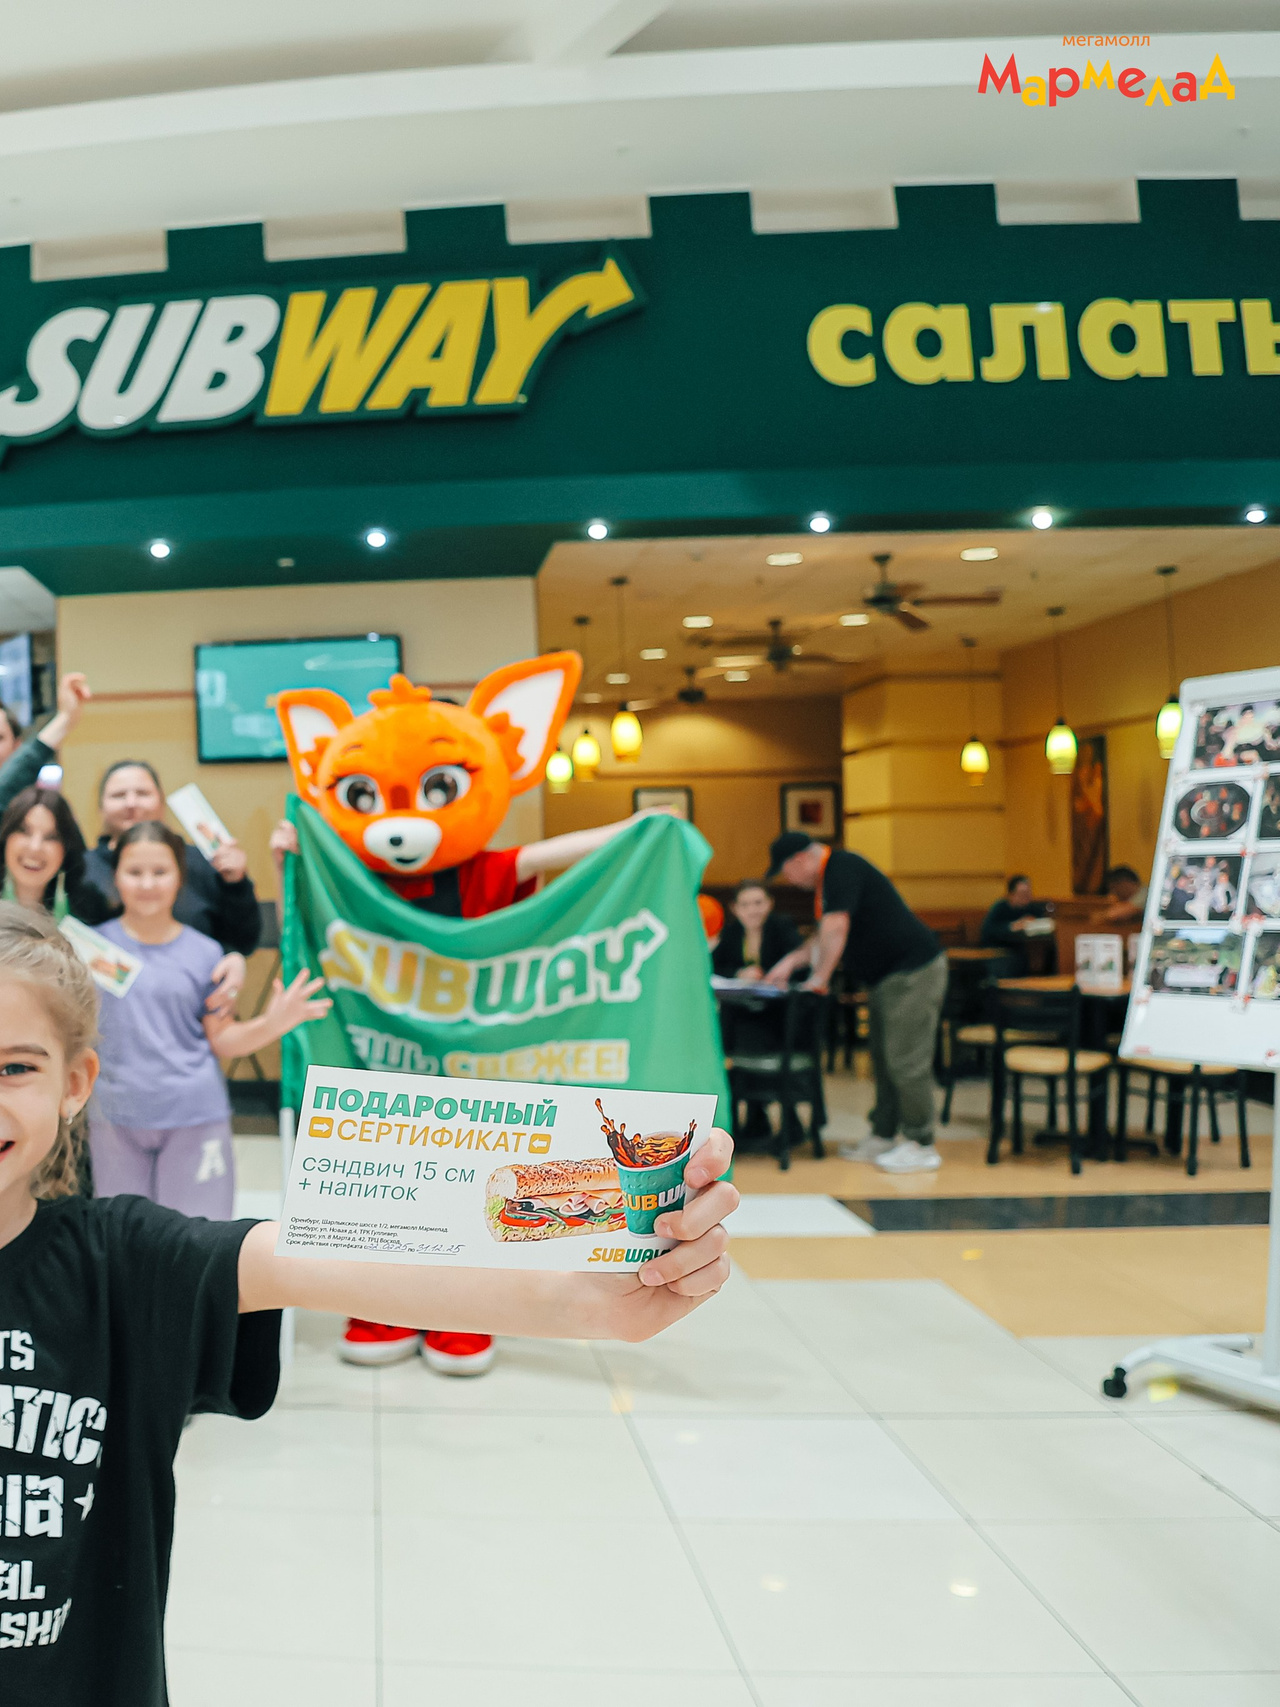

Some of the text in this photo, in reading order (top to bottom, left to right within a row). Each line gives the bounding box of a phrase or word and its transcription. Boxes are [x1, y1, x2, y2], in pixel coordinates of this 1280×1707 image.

[320, 909, 667, 1025] SUBWAY
[312, 1085, 558, 1127] ПОДАРОЧНЫЙ
[337, 1118, 526, 1153] СЕРТИФИКАТ
[302, 1156, 476, 1183] сэндвич 15 см
[319, 1180, 419, 1201] напиток
[289, 1224, 319, 1233] Оренбург,
[290, 1216, 321, 1225] Оренбург,
[321, 1219, 359, 1227] Шарлыкское
[286, 1238, 301, 1246] Срок
[287, 1231, 317, 1240] Оренбург,
[332, 1234, 351, 1242] Марта
